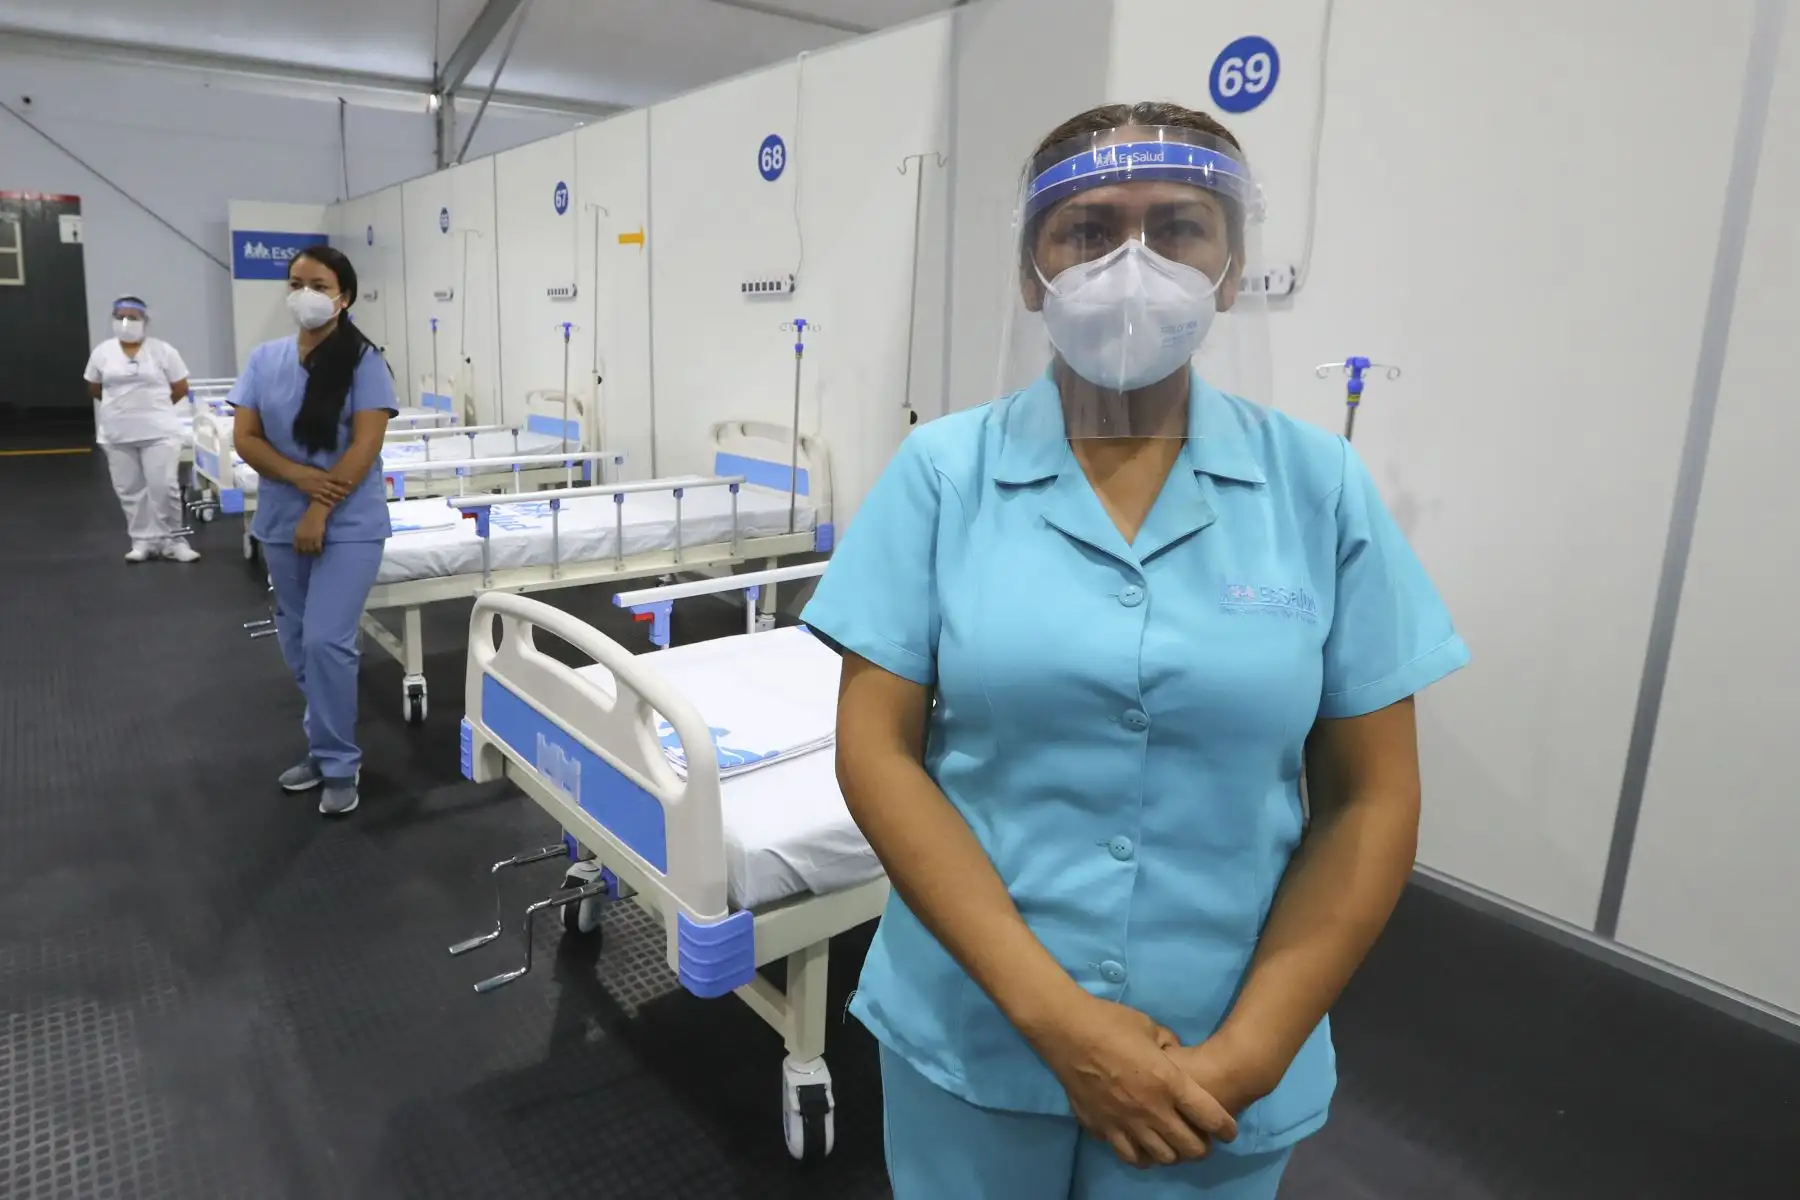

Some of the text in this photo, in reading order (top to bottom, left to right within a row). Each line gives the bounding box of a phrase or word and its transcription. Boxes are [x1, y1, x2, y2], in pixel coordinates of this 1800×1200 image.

[1218, 51, 1272, 98] 69
[761, 144, 783, 172] 68
[1119, 151, 1165, 165] EsSalud
[555, 189, 568, 208] 67
